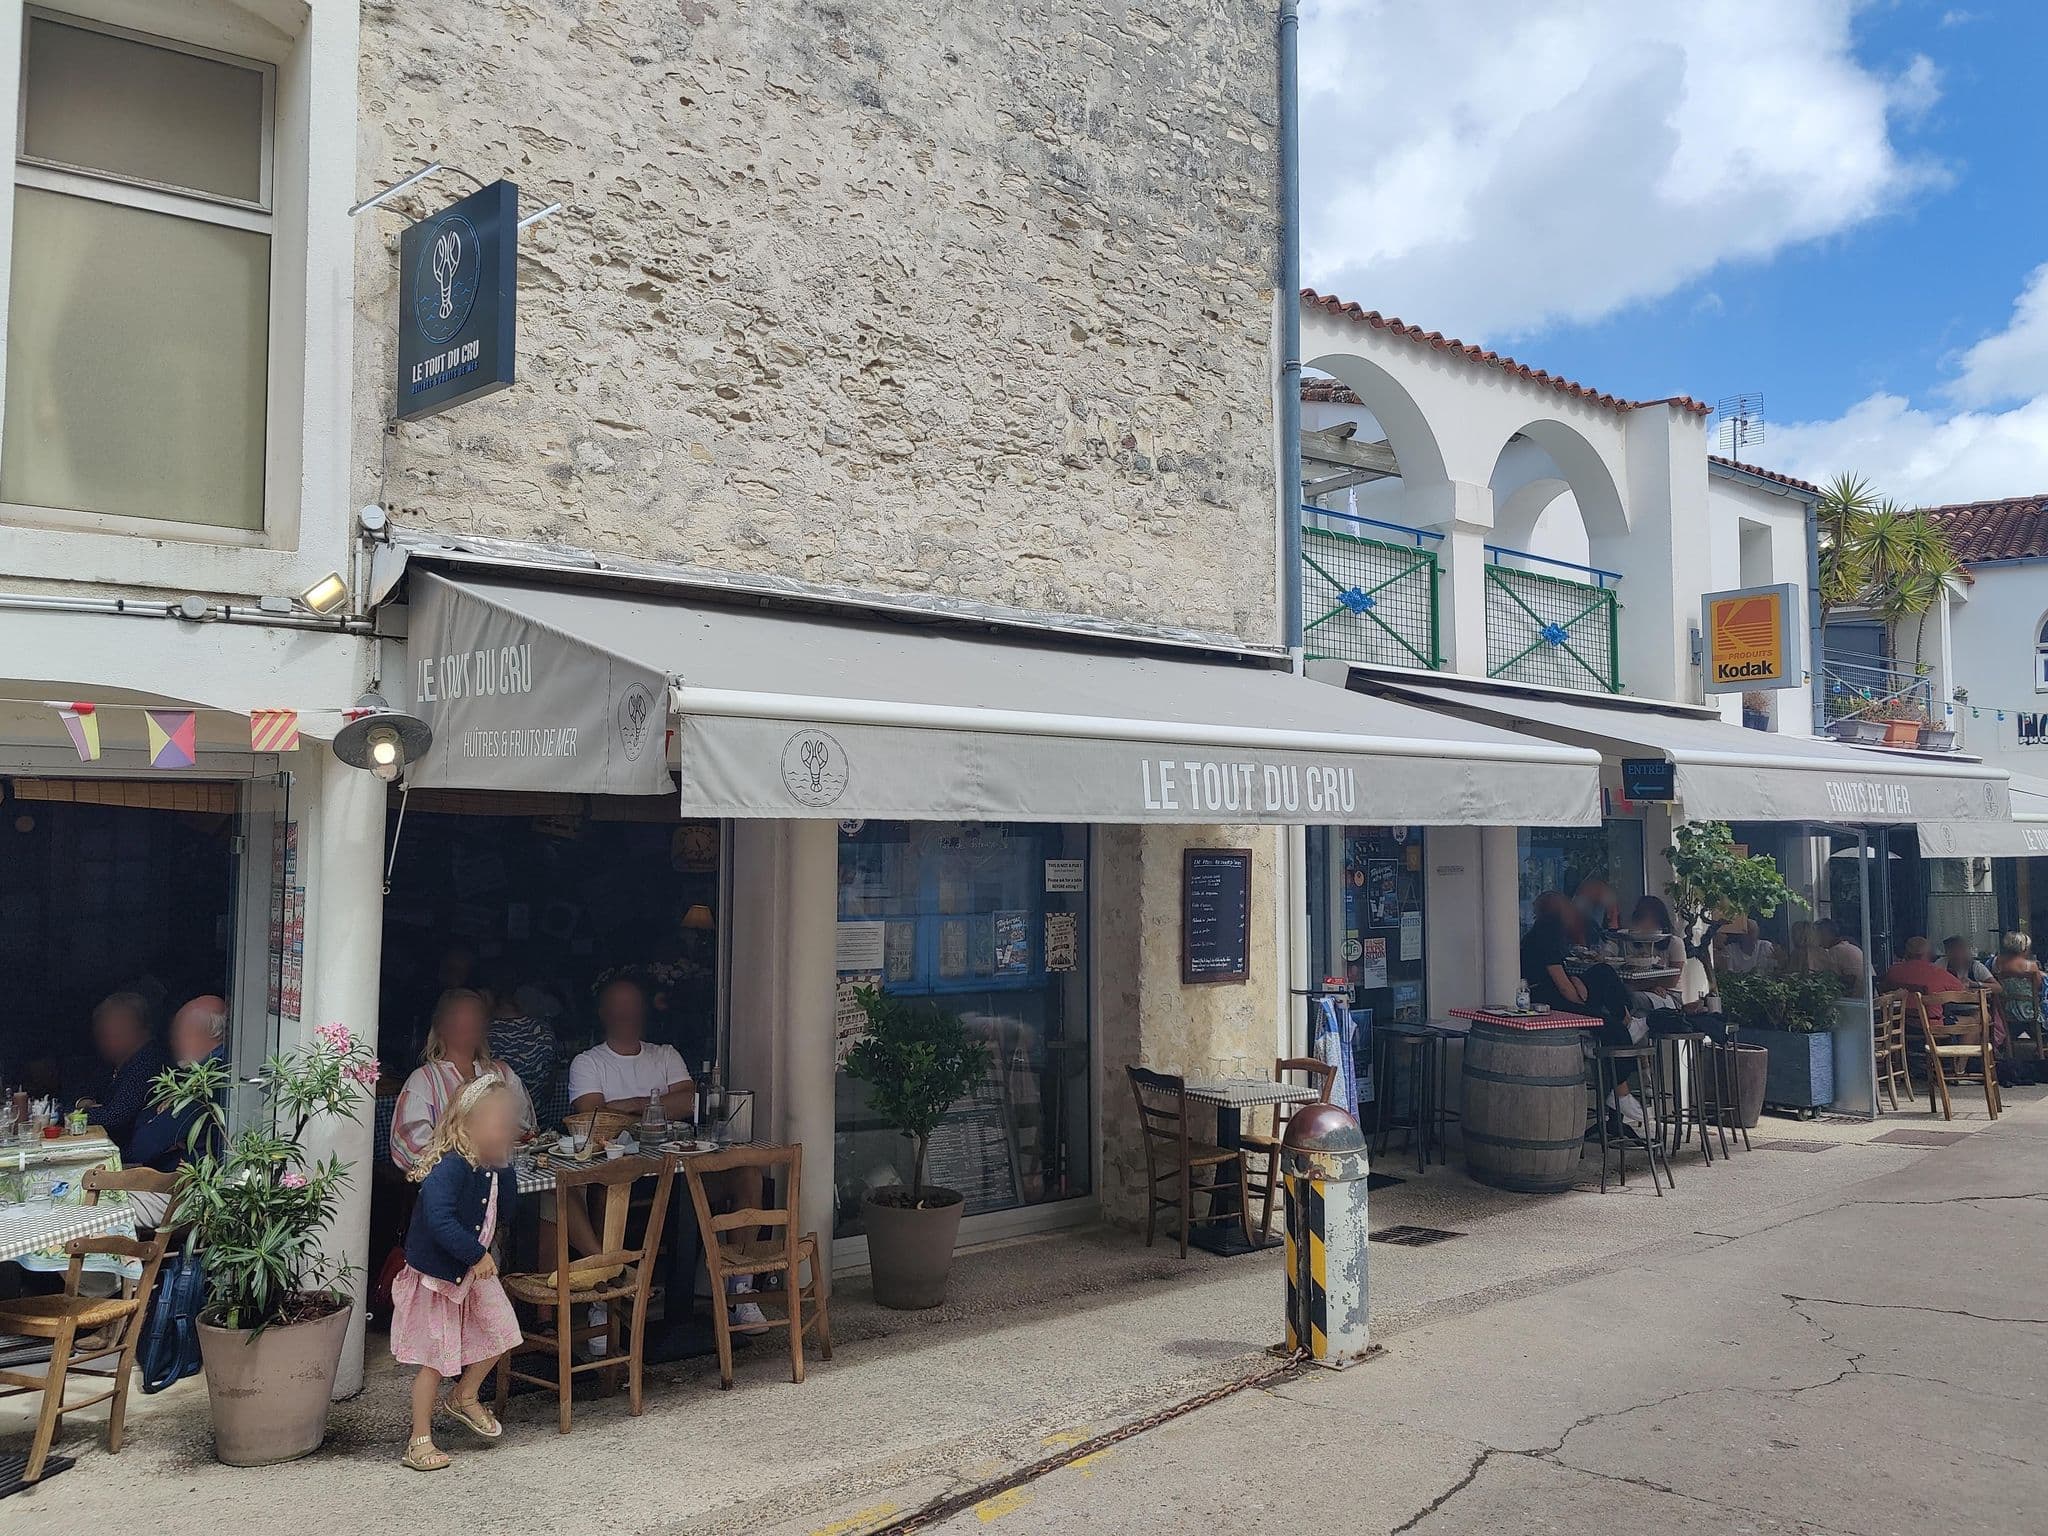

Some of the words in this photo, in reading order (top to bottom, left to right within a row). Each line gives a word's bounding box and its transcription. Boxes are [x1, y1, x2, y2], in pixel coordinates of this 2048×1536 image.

[412, 363, 423, 384] LE
[424, 353, 446, 378] TOUT
[447, 347, 460, 370] DU
[461, 339, 480, 364] CRU
[1718, 660, 1774, 678] Kodak
[1728, 649, 1774, 660] PRODUITS
[417, 658, 437, 702] LE
[440, 652, 470, 700] TOUT
[475, 648, 495, 697] DU
[500, 643, 532, 695] CRU
[463, 727, 500, 758] HUÎTRES
[501, 730, 508, 757] &
[509, 729, 541, 758] FRUITS
[541, 728, 554, 757] DE
[554, 727, 578, 758] MER
[1141, 759, 1179, 810] LE
[1184, 761, 1255, 811] TOUT
[1263, 764, 1299, 811] DU
[1306, 766, 1356, 813] CRU
[1825, 781, 1870, 812] FRUITS
[1868, 783, 1887, 813] DE
[1885, 784, 1912, 814] MER
[2021, 829, 2038, 850] LE
